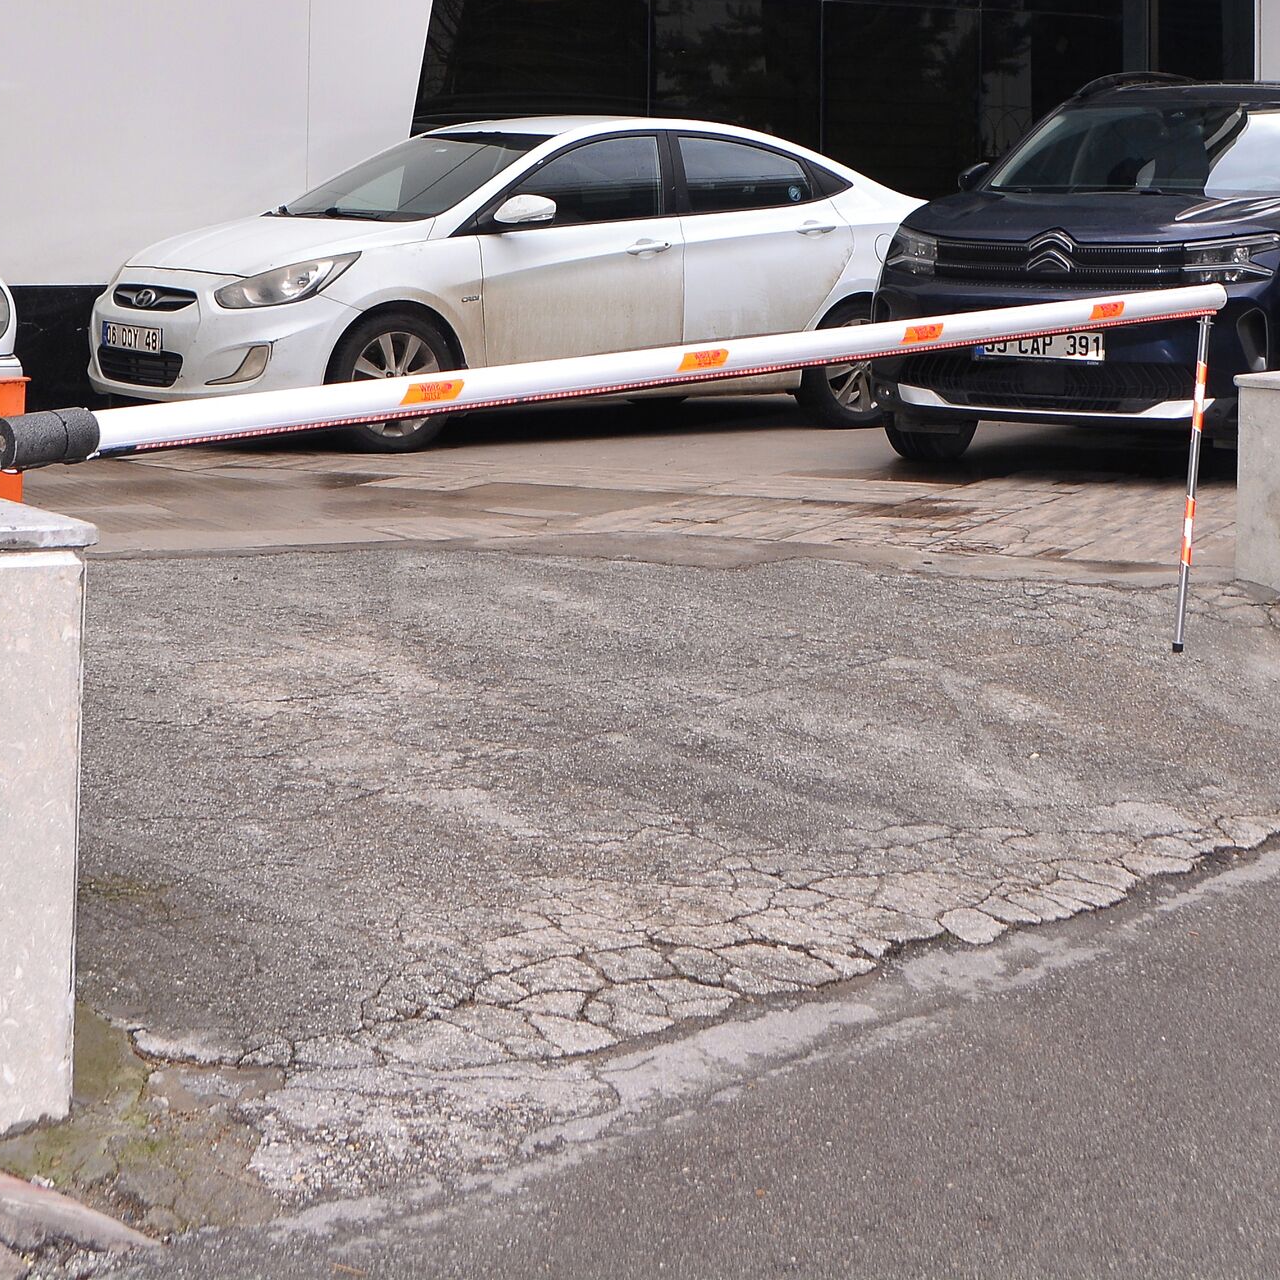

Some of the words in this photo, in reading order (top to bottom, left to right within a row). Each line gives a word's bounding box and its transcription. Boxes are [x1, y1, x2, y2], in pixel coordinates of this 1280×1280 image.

[144, 330, 158, 351] 48
[1018, 336, 1053, 355] CAP
[1066, 335, 1100, 357] 391
